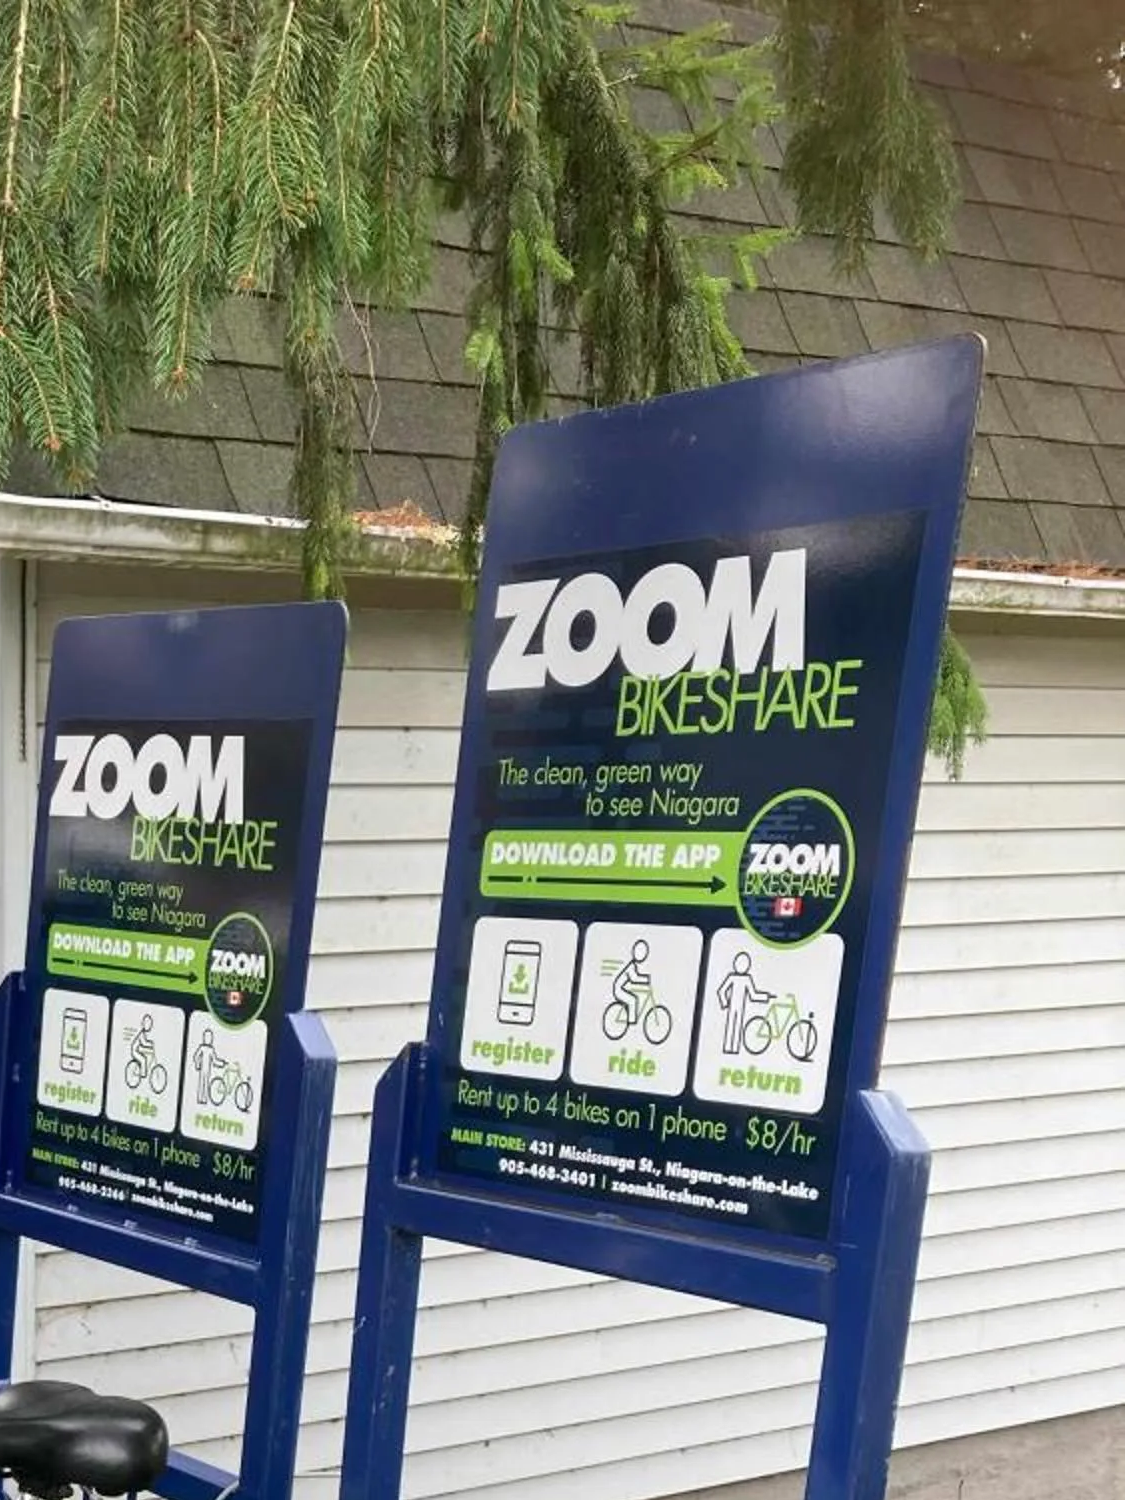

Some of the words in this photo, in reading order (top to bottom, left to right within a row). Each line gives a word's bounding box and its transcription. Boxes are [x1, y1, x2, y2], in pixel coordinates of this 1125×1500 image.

[486, 548, 807, 691] ZOOM
[615, 659, 864, 737] BIKESHARE
[49, 733, 245, 825] ZOOM
[499, 757, 528, 785] The
[534, 756, 588, 788] clean,
[596, 764, 651, 792] green
[660, 763, 704, 791] way
[586, 792, 604, 817] to
[609, 798, 644, 817] see
[649, 788, 740, 825] Niagara
[130, 815, 278, 871] BIKESHARE
[491, 842, 616, 868] DOWNLOAD
[624, 843, 665, 868] THE
[671, 844, 723, 869] APP
[747, 843, 841, 876] ZOOM
[58, 869, 76, 890] The
[118, 880, 154, 901] green
[157, 884, 184, 906] way
[744, 870, 838, 898] BIKESHARE
[112, 902, 124, 919] to
[126, 908, 148, 922] see
[150, 902, 206, 932] Niagara
[53, 931, 132, 959] DOWNLOAD
[136, 941, 162, 962] THE
[165, 946, 196, 966] APP
[211, 950, 266, 979] ZOOM
[471, 1038, 555, 1066] register
[608, 1049, 657, 1077] ride
[44, 1081, 96, 1105] register
[719, 1066, 802, 1095] return
[128, 1096, 158, 1118] ride
[194, 1112, 244, 1136] return
[458, 1079, 493, 1106] Rent
[496, 1093, 519, 1119] up
[524, 1091, 540, 1115] to
[545, 1094, 558, 1117] 4
[564, 1092, 610, 1125] bikes
[615, 1107, 640, 1129] on
[648, 1103, 656, 1131] 1
[662, 1104, 727, 1142] phone
[746, 1115, 817, 1155] $8/hr
[36, 1112, 59, 1134] Rent
[91, 1128, 100, 1144] 4
[102, 1126, 130, 1151] bikes
[133, 1139, 150, 1156] on
[160, 1139, 201, 1168] phone
[213, 1151, 255, 1180] $8/hr
[450, 1127, 483, 1145] MAIN
[485, 1133, 525, 1153] STORE:
[529, 1139, 554, 1157] 431
[558, 1144, 636, 1173] Mississauga
[499, 1157, 596, 1188] 905-468-3401
[611, 1180, 748, 1215] zoombikeshare.com
